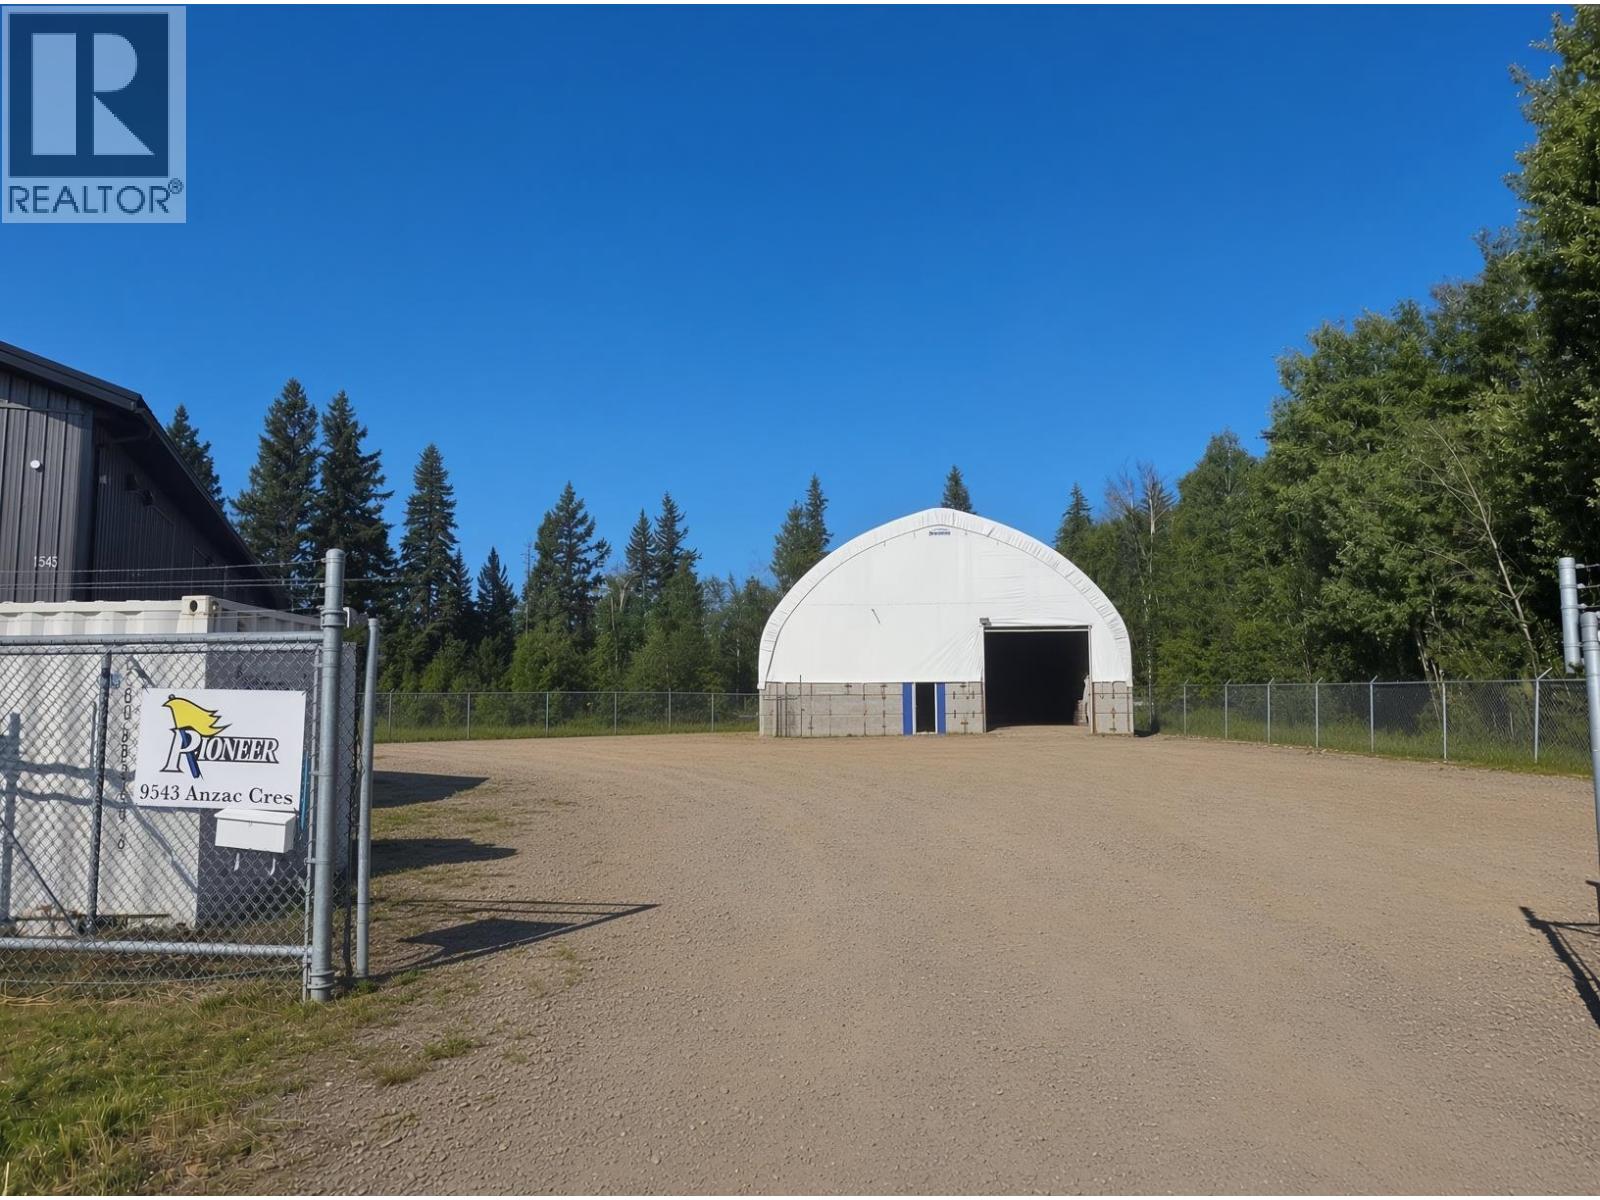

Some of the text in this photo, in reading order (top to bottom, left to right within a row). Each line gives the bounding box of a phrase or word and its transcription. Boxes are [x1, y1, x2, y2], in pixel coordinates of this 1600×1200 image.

[160, 727, 279, 774] PIONEER
[139, 784, 293, 805] 9543 Anzac Cres
